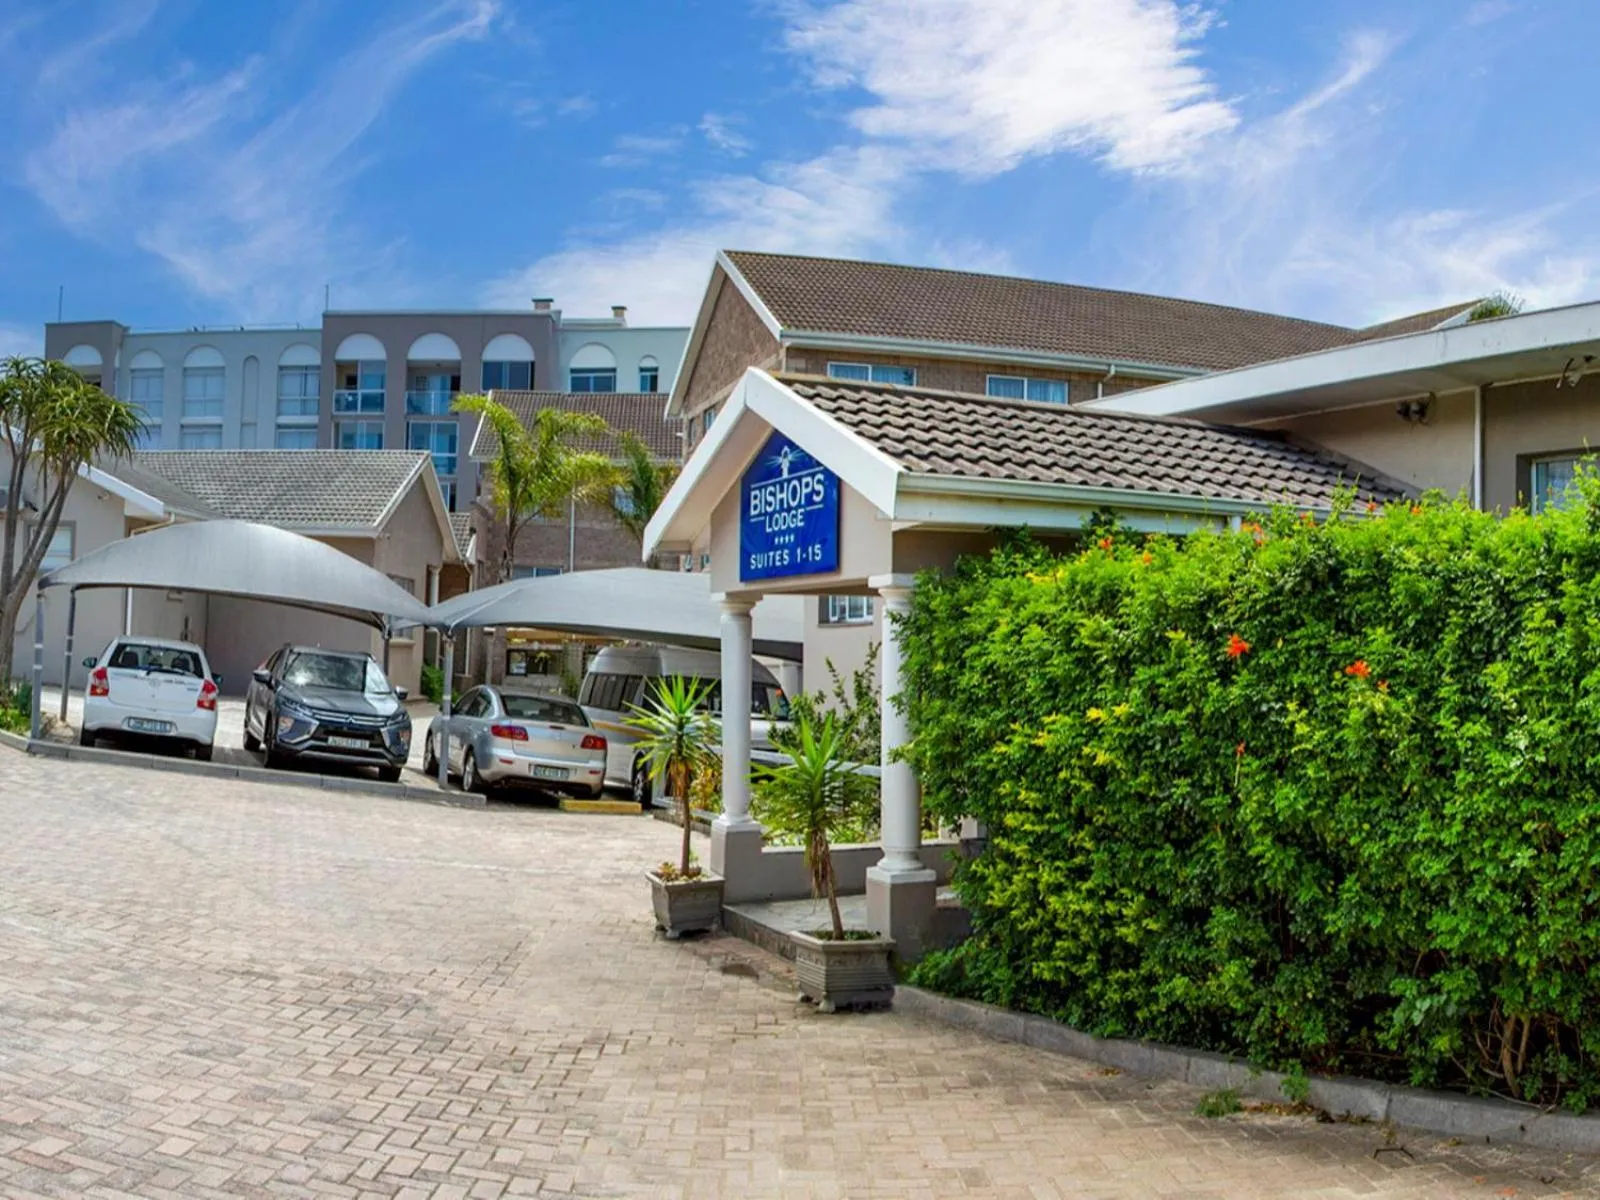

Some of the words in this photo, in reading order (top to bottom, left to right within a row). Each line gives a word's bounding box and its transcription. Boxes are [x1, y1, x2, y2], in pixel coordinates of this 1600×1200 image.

[750, 473, 824, 516] BISHOPS
[766, 508, 804, 532] LODGE
[750, 549, 789, 569] SUITES
[797, 544, 822, 563] 1-15
